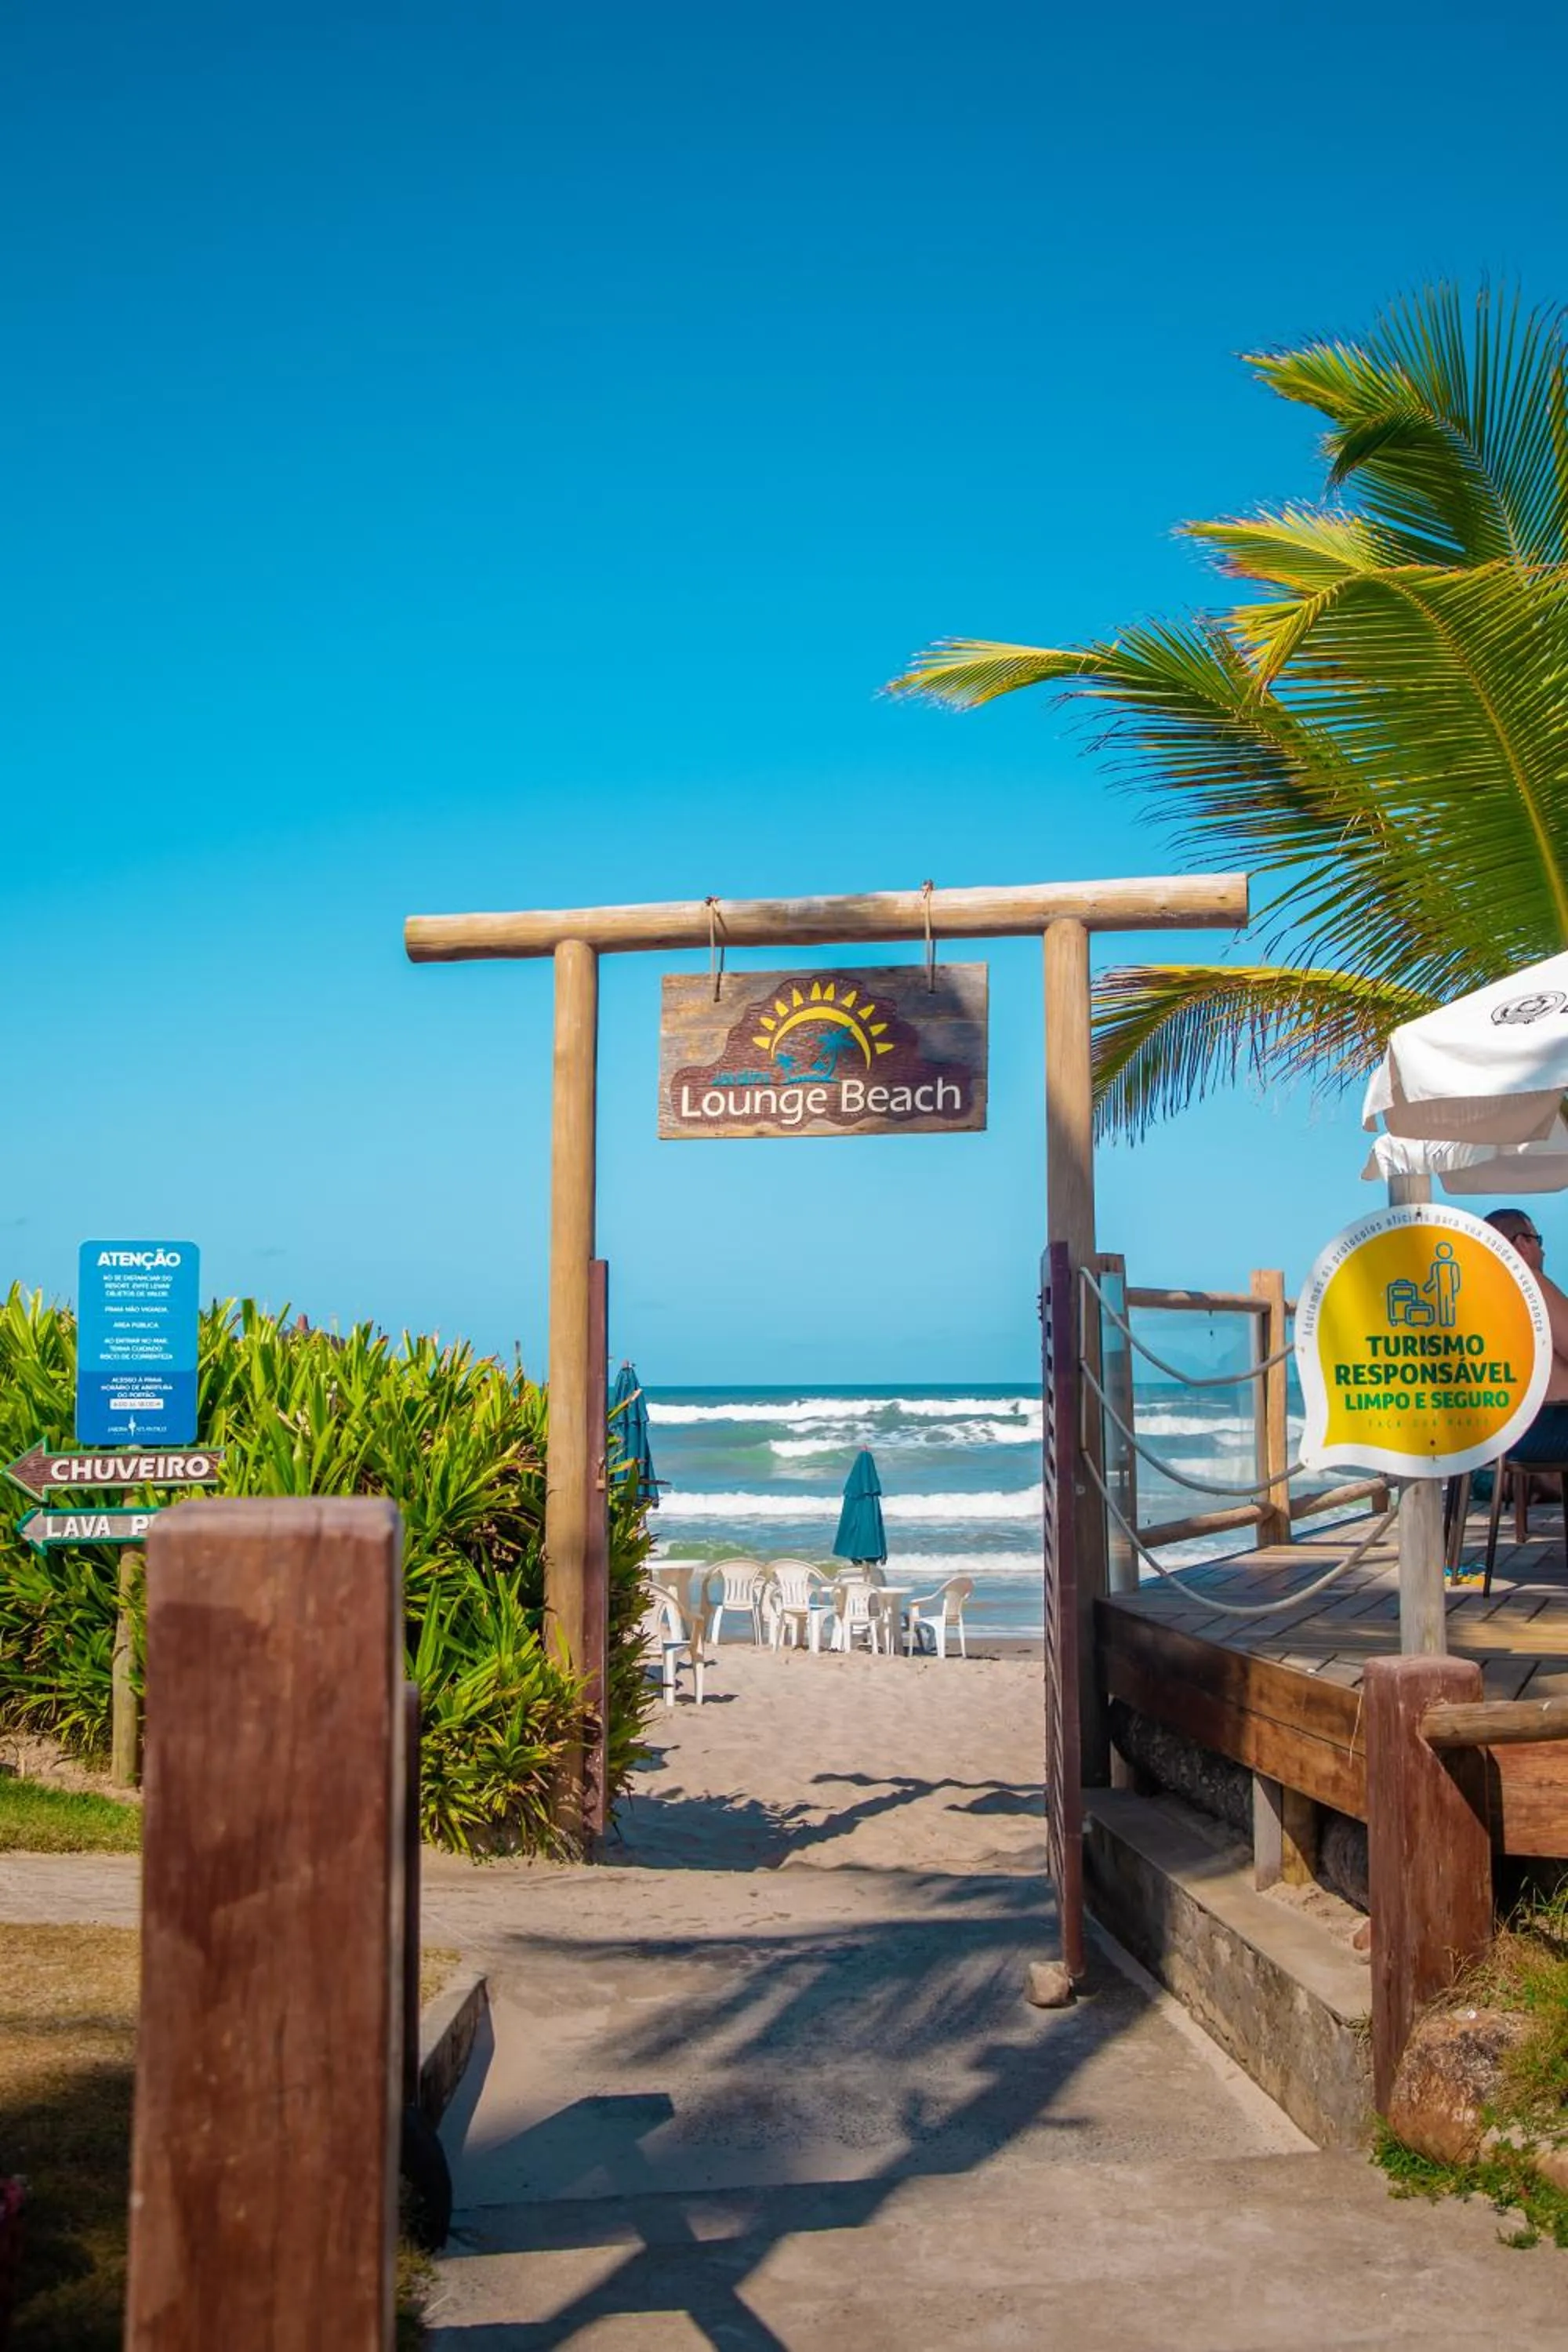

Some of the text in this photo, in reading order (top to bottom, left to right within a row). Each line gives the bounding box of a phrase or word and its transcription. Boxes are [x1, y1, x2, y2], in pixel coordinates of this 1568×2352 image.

[681, 1077, 961, 1125] Lounge Beach
[96, 1248, 181, 1270] ATENÇÃO
[1366, 1334, 1484, 1357] TURISMO
[1334, 1356, 1518, 1386] RESPONSÁVEL
[1345, 1390, 1509, 1411] LIMPO E SEGURO
[51, 1455, 211, 1481] CHUVEIRO
[46, 1515, 111, 1537] LAVA
